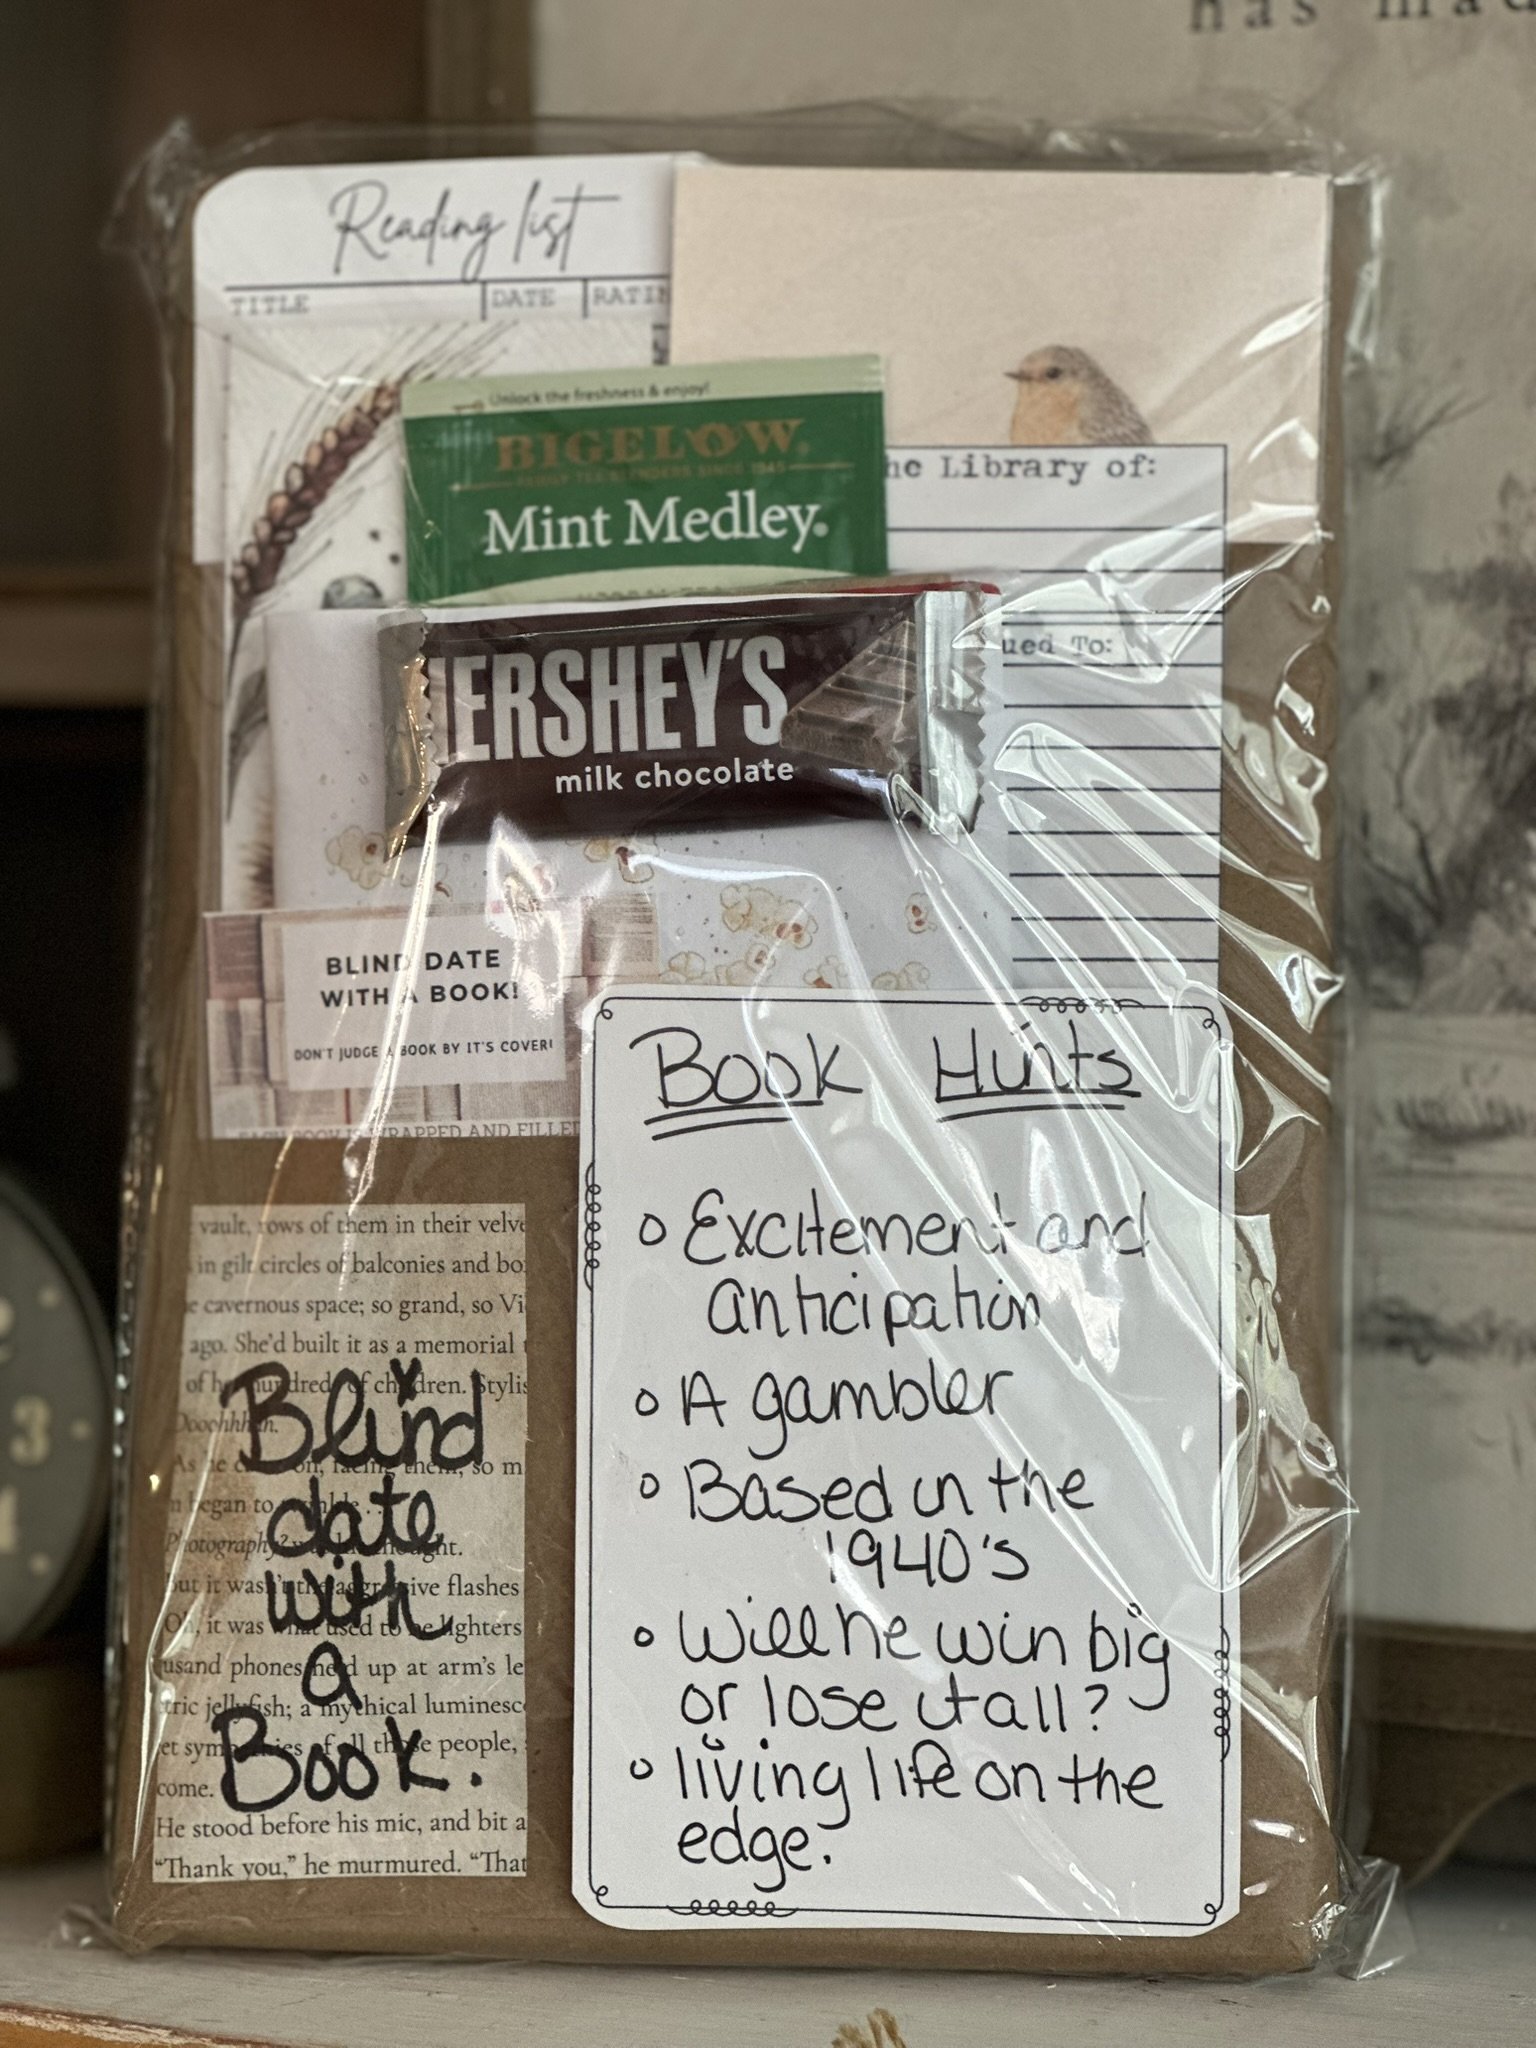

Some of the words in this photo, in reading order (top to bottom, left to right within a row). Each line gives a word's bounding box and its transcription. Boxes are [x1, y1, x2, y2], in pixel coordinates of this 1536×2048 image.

[329, 179, 505, 282] Reading
[514, 180, 620, 272] list
[231, 295, 309, 314] TITLE
[492, 288, 554, 308] DATE
[490, 392, 539, 405] Unlock
[546, 391, 568, 402] the
[574, 387, 644, 401] freshness
[650, 386, 658, 396] &
[664, 382, 710, 396] enjoy!
[885, 453, 923, 478] he
[942, 454, 1087, 485] Library
[1106, 454, 1156, 478] of:
[484, 505, 611, 555] Mint
[1071, 635, 1112, 656] To:
[555, 766, 622, 794] milk
[635, 757, 794, 789] chocolate
[425, 949, 500, 971] DATE
[320, 987, 389, 1007] WITH
[430, 981, 519, 1003] BOOK!
[294, 1047, 333, 1061] DON'T
[339, 1046, 378, 1062] JUDGE
[400, 1043, 437, 1057] BOOK
[443, 1043, 460, 1054] BY
[467, 1042, 495, 1054] IT'S
[500, 1039, 553, 1053] COVER!
[629, 1027, 863, 1109] Book
[934, 1019, 1133, 1096] Hints
[468, 1122, 511, 1137] AND
[200, 1214, 252, 1236] vault,
[258, 1221, 303, 1234] rows
[310, 1211, 333, 1234] of
[338, 1212, 387, 1234] them
[396, 1214, 414, 1233] in
[423, 1212, 471, 1233] their
[684, 1188, 1016, 1264] Excitement
[1036, 1191, 1151, 1256] and
[198, 1254, 215, 1274] in
[222, 1252, 253, 1282] gilt
[260, 1252, 320, 1274] circles
[352, 1251, 445, 1274] balconies
[452, 1251, 489, 1273] and
[497, 1251, 526, 1273] bo
[204, 1300, 300, 1314] cavernous
[306, 1300, 364, 1321] space;
[372, 1300, 392, 1314] so
[400, 1292, 465, 1322] grand,
[472, 1300, 493, 1314] so
[500, 1293, 526, 1313] Vi
[707, 1265, 1041, 1346] anticipation
[190, 1340, 228, 1361] ago.
[236, 1331, 285, 1353] She'd
[293, 1331, 339, 1353] built
[348, 1334, 361, 1353] it
[369, 1339, 388, 1354] as
[396, 1340, 406, 1354] a
[415, 1332, 514, 1354] memorial
[186, 1370, 209, 1393] of
[374, 1371, 466, 1394] chdren.
[220, 1358, 483, 1475] Blind
[681, 1371, 726, 1427] A
[748, 1358, 1014, 1460] gambler
[11, 1396, 50, 1467] 3
[472, 1460, 493, 1475] so
[684, 1458, 892, 1523] Based
[989, 1457, 1094, 1512] the
[254, 1498, 273, 1514] to
[268, 1475, 444, 1557] date
[825, 1528, 1030, 1588] 1940's
[207, 1574, 221, 1593] it
[448, 1573, 519, 1596] flashes
[265, 1555, 453, 1641] with
[207, 1611, 221, 1634] it
[228, 1620, 264, 1634] was
[163, 1653, 221, 1675] usand
[231, 1653, 302, 1683] phones
[368, 1661, 396, 1684] up
[408, 1660, 427, 1676] at
[439, 1656, 495, 1676] arm's
[836, 1603, 921, 1660] he
[938, 1613, 1066, 1665] win
[1090, 1602, 1171, 1711] big
[302, 1641, 362, 1710] a
[301, 1703, 311, 1718] a
[425, 1693, 526, 1715] luminesc
[681, 1682, 738, 1726] or
[764, 1675, 897, 1731] lose
[438, 1731, 517, 1759] people,
[866, 1738, 956, 1802] life
[976, 1759, 1046, 1804] on
[1058, 1753, 1163, 1809] the
[157, 1783, 214, 1798] come.
[157, 1817, 184, 1838] He
[193, 1814, 253, 1838] stood
[261, 1812, 329, 1835] before
[337, 1811, 368, 1833] his
[376, 1813, 421, 1836] mic,
[430, 1809, 470, 1832] and
[478, 1808, 507, 1831] bit
[516, 1817, 526, 1831] a
[304, 1852, 329, 1876] he
[338, 1850, 461, 1874] murmured.
[678, 1805, 832, 1891] edge.
